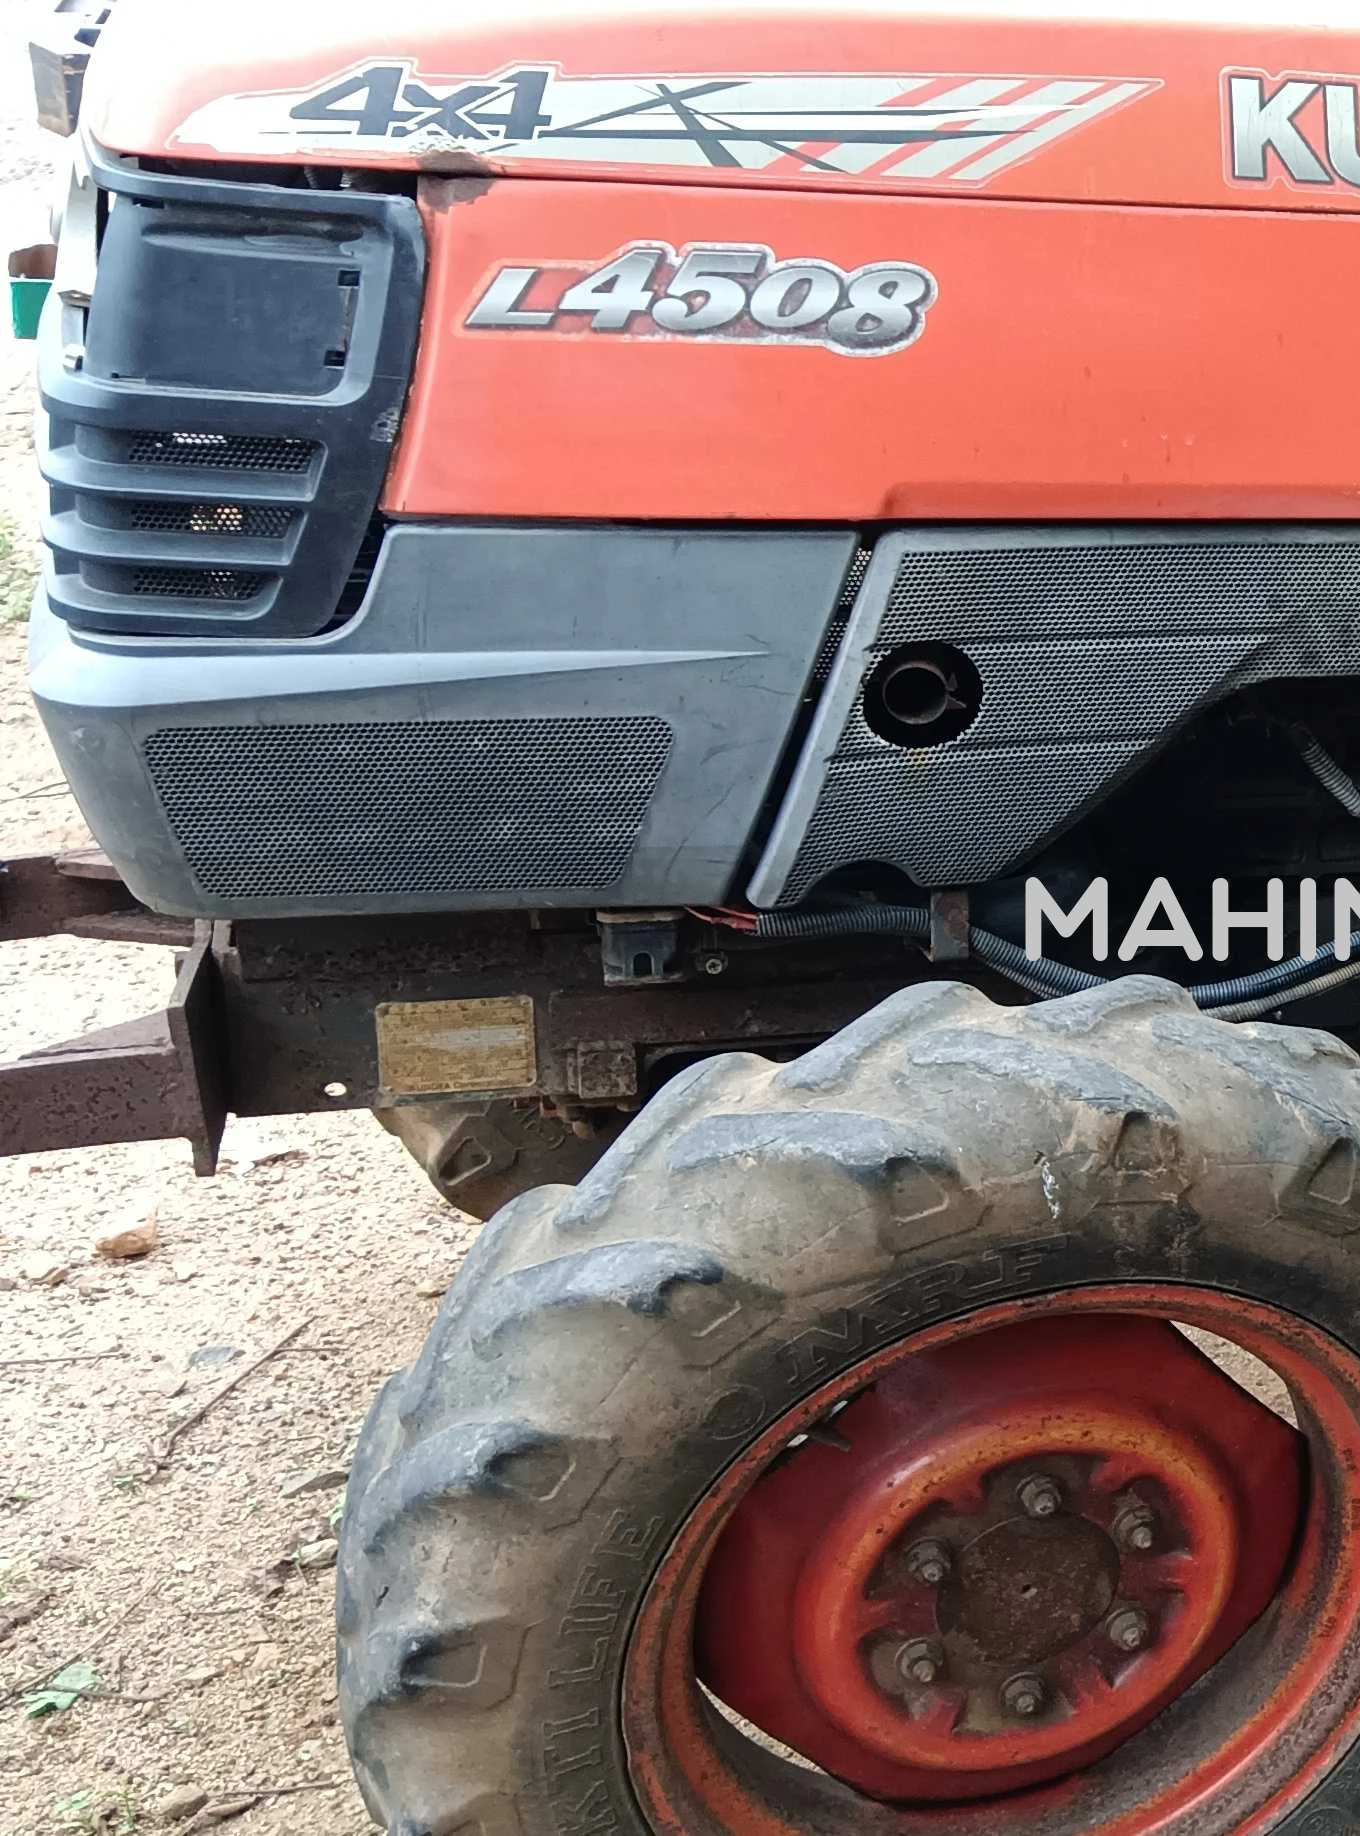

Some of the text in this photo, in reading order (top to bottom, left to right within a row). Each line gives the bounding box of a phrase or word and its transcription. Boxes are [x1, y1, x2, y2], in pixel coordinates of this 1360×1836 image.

[289, 66, 553, 141] 4x4
[464, 247, 931, 350] L4508
[546, 1508, 665, 1690] LIFE
